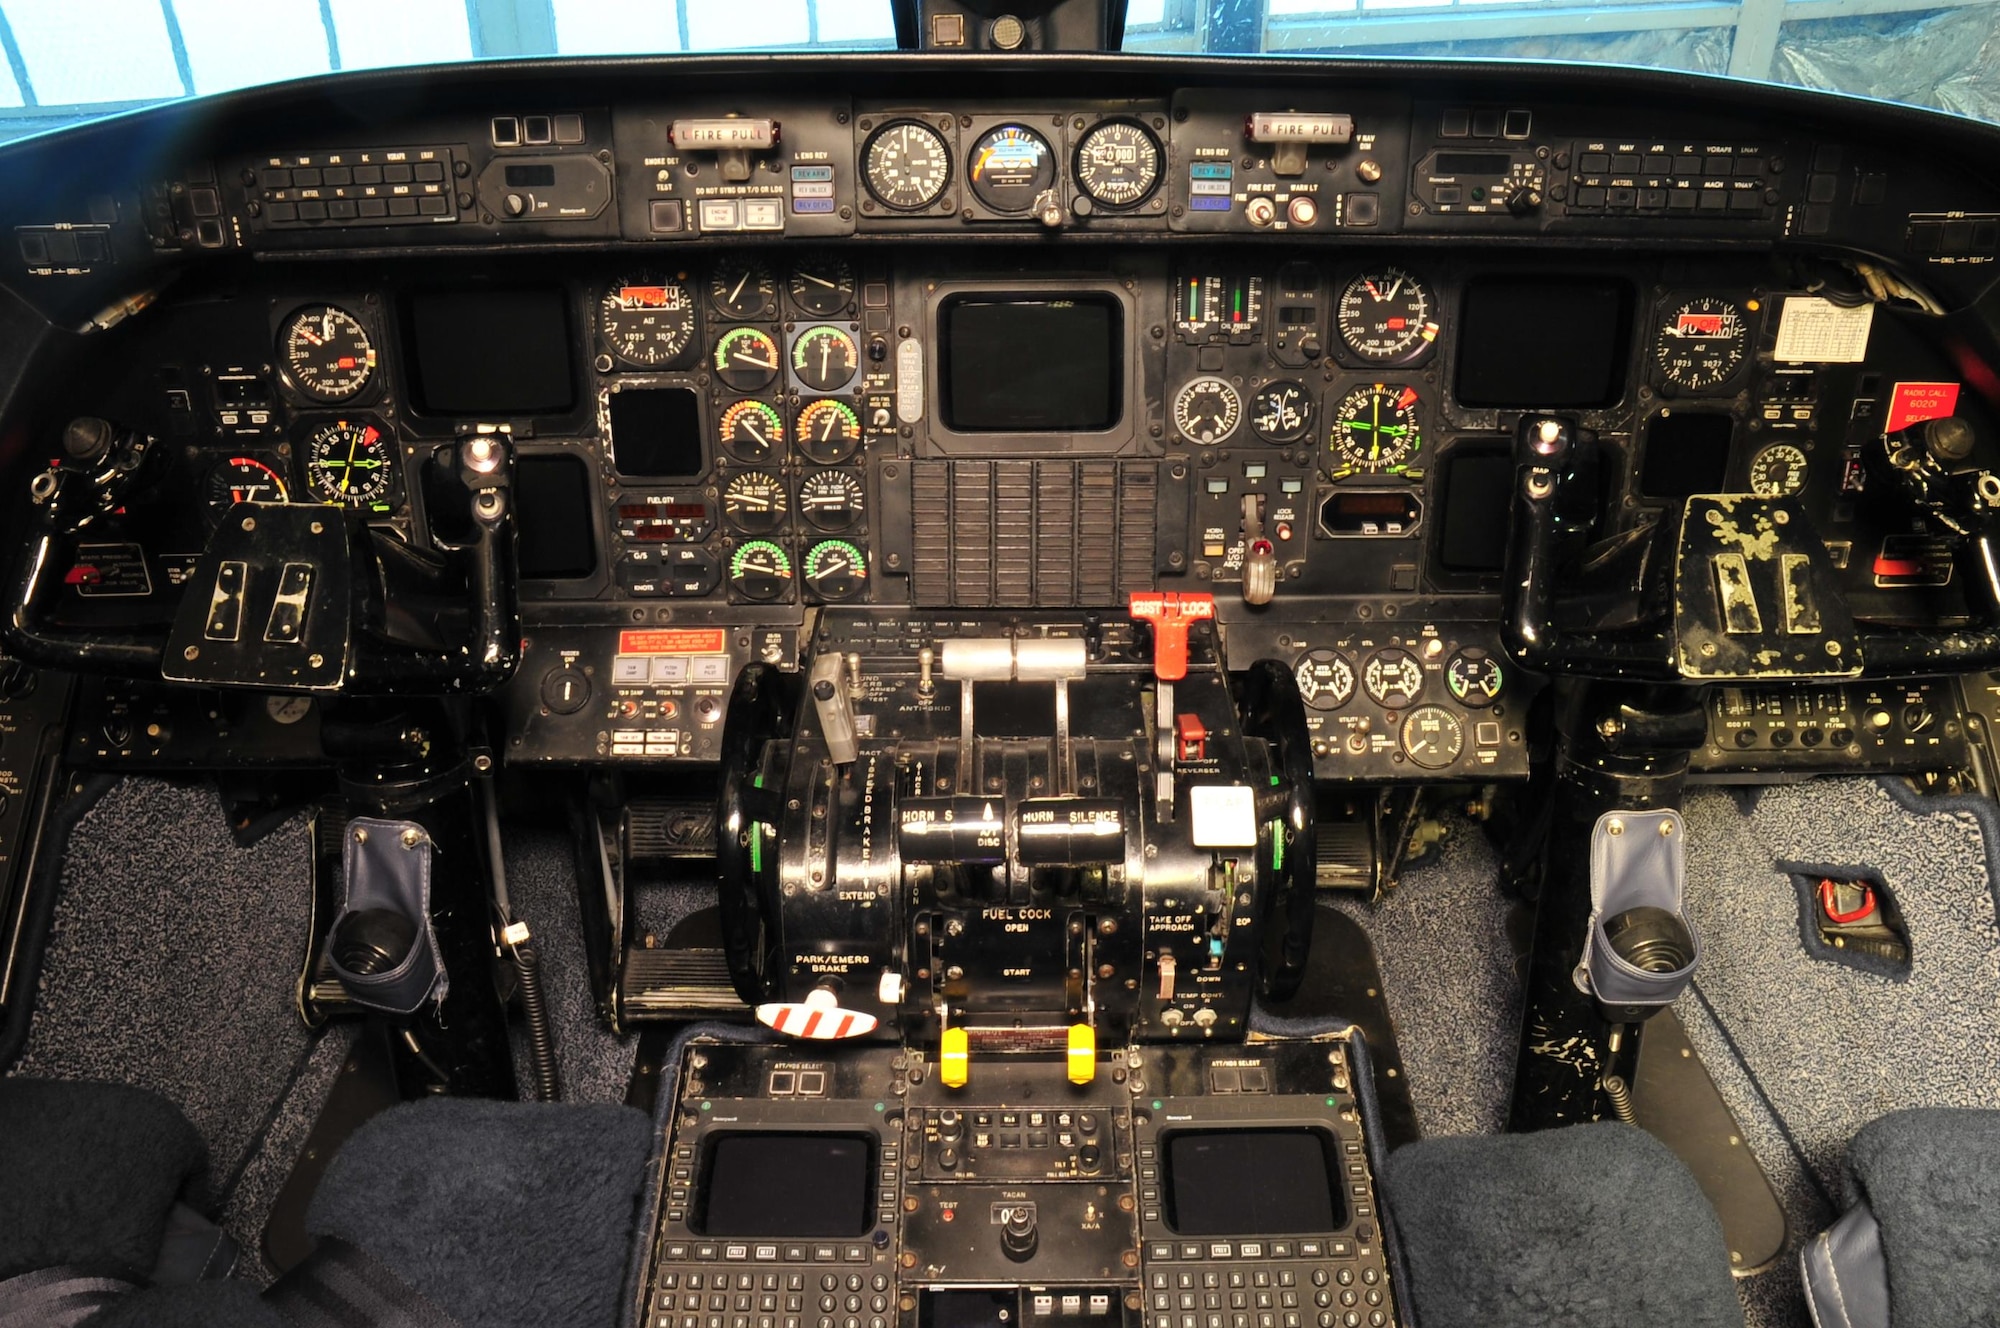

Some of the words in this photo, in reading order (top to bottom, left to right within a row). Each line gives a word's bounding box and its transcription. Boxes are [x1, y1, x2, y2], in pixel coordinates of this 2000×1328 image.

[1262, 124, 1269, 134] R
[1277, 124, 1303, 135] FIRE
[1313, 125, 1344, 136] PULL
[682, 131, 687, 140] L
[694, 130, 722, 140] FIRE
[732, 129, 763, 140] PULL
[1618, 143, 1634, 152] NAV
[1258, 160, 1264, 168] 2
[656, 183, 673, 192] TEST
[1346, 310, 1360, 318] 250
[642, 317, 656, 325] ALT
[1406, 318, 1418, 326] 140
[1220, 322, 1232, 330] OIL
[1233, 322, 1251, 330] PRESS
[1375, 322, 1388, 330] IAS
[624, 333, 645, 341] 1025
[1693, 344, 1706, 352] ALT
[1902, 389, 1925, 397] RADIO
[1928, 389, 1948, 397] CALL
[646, 496, 662, 504] FUEL
[633, 552, 648, 560] G/S
[1130, 601, 1162, 615] GUST
[1181, 601, 1212, 615] LOCK
[902, 810, 936, 822] HORN
[944, 811, 954, 822] S
[1069, 810, 1118, 822] SILENCE
[977, 837, 1000, 847] DISC
[838, 891, 876, 900] EXTEND
[982, 908, 1014, 920] FUEL
[1018, 908, 1052, 920] COCK
[1149, 916, 1172, 924] TAKE
[1174, 916, 1192, 924] OFF
[1004, 923, 1030, 932] OPEN
[1149, 924, 1194, 932] APPROACH
[795, 954, 870, 964] PARK/EMERG
[811, 964, 849, 973] BRAKE
[1003, 968, 1032, 977] START
[1183, 1276, 1188, 1284] B
[1208, 1275, 1214, 1284] C
[1319, 1273, 1323, 1281] 1
[1343, 1273, 1349, 1281] 2
[1368, 1272, 1374, 1280] 3
[666, 1276, 672, 1285] A
[692, 1277, 697, 1285] B
[717, 1277, 722, 1285] C
[827, 1278, 831, 1286] 1
[852, 1278, 857, 1287] 2
[877, 1278, 882, 1287] 3
[1158, 1276, 1163, 1285] A
